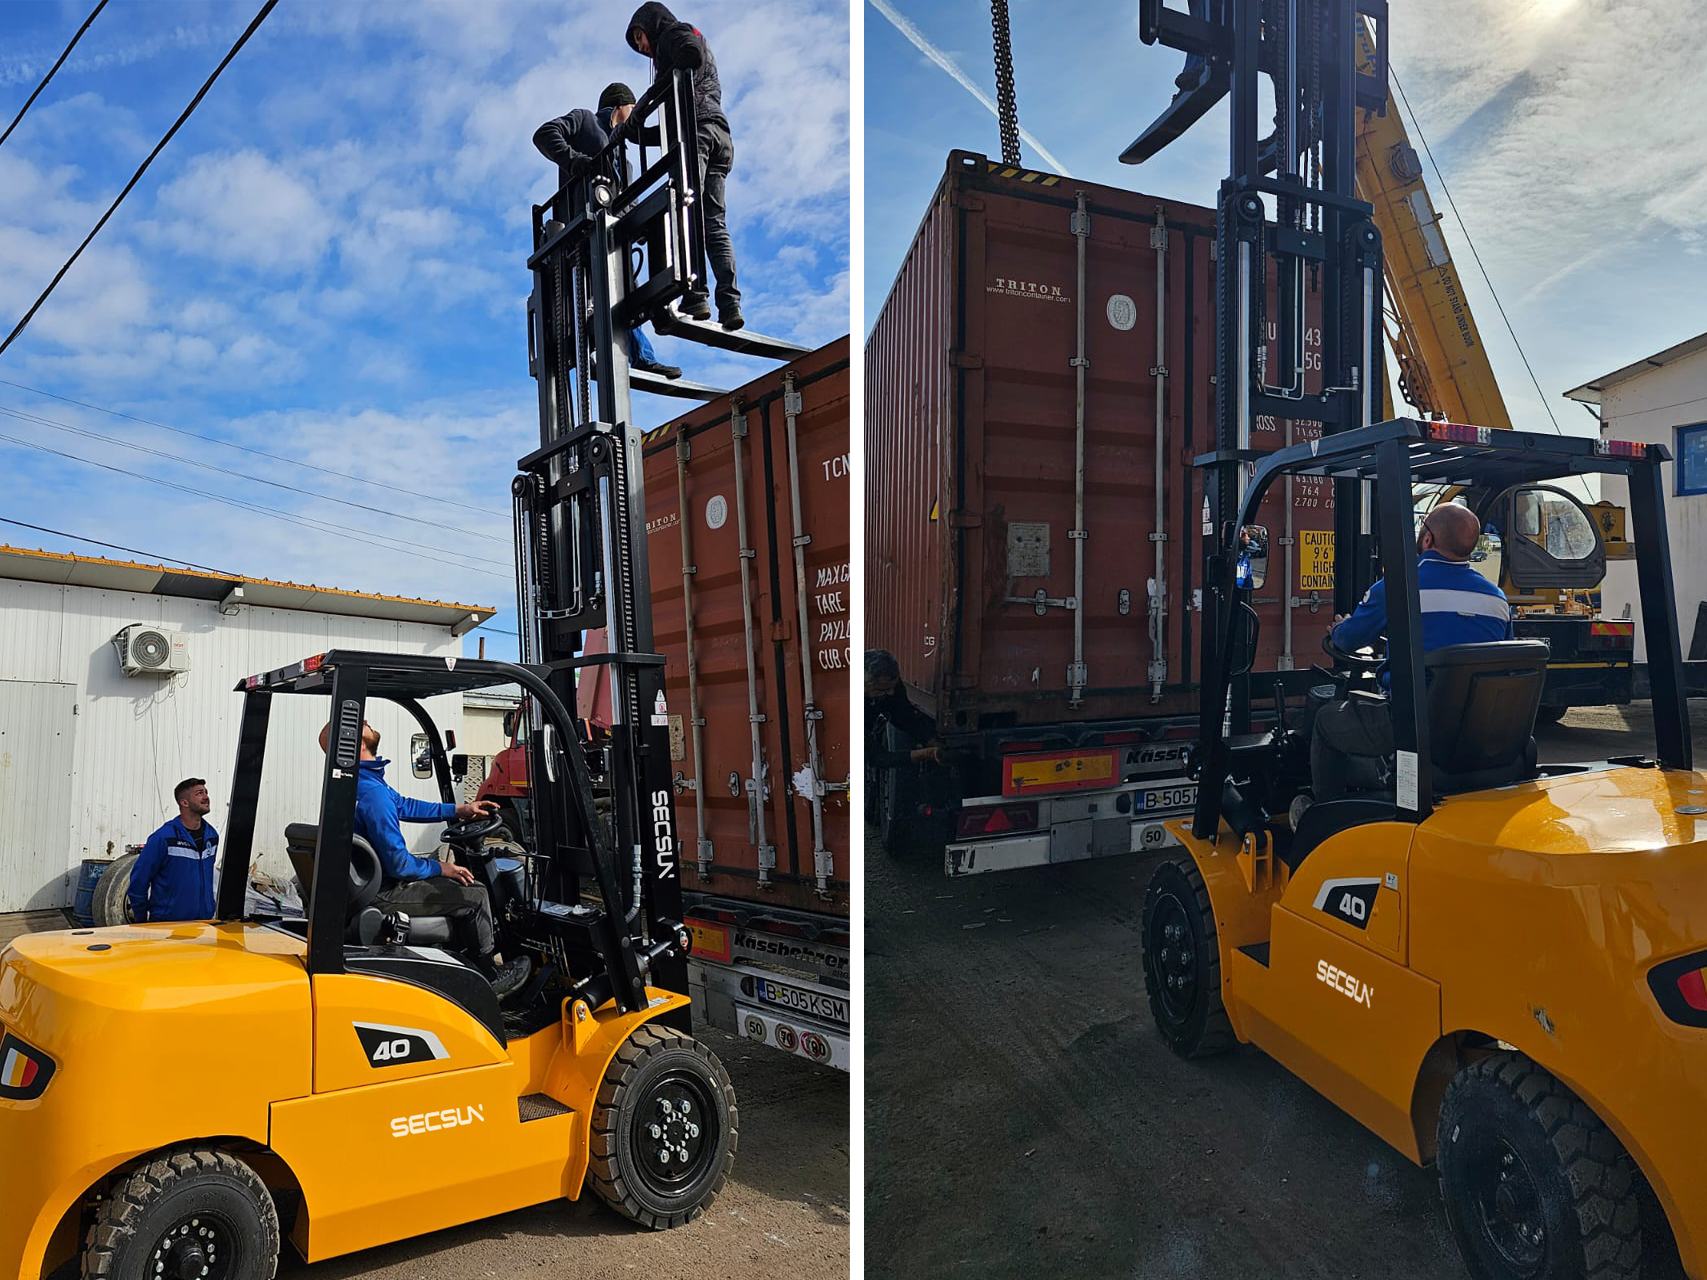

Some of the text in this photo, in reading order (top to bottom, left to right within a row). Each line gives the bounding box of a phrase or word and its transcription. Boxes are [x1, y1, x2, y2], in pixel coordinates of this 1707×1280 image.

[996, 278, 1062, 296] TRITON
[815, 591, 846, 615] TARE
[652, 790, 675, 879] SECSUN
[1146, 830, 1161, 843] 50
[1339, 893, 1366, 921] 40
[1316, 959, 1374, 1009] SECSUN
[749, 1021, 763, 1036] 50
[373, 1038, 411, 1061] 40
[390, 1104, 485, 1138] SECSUN
